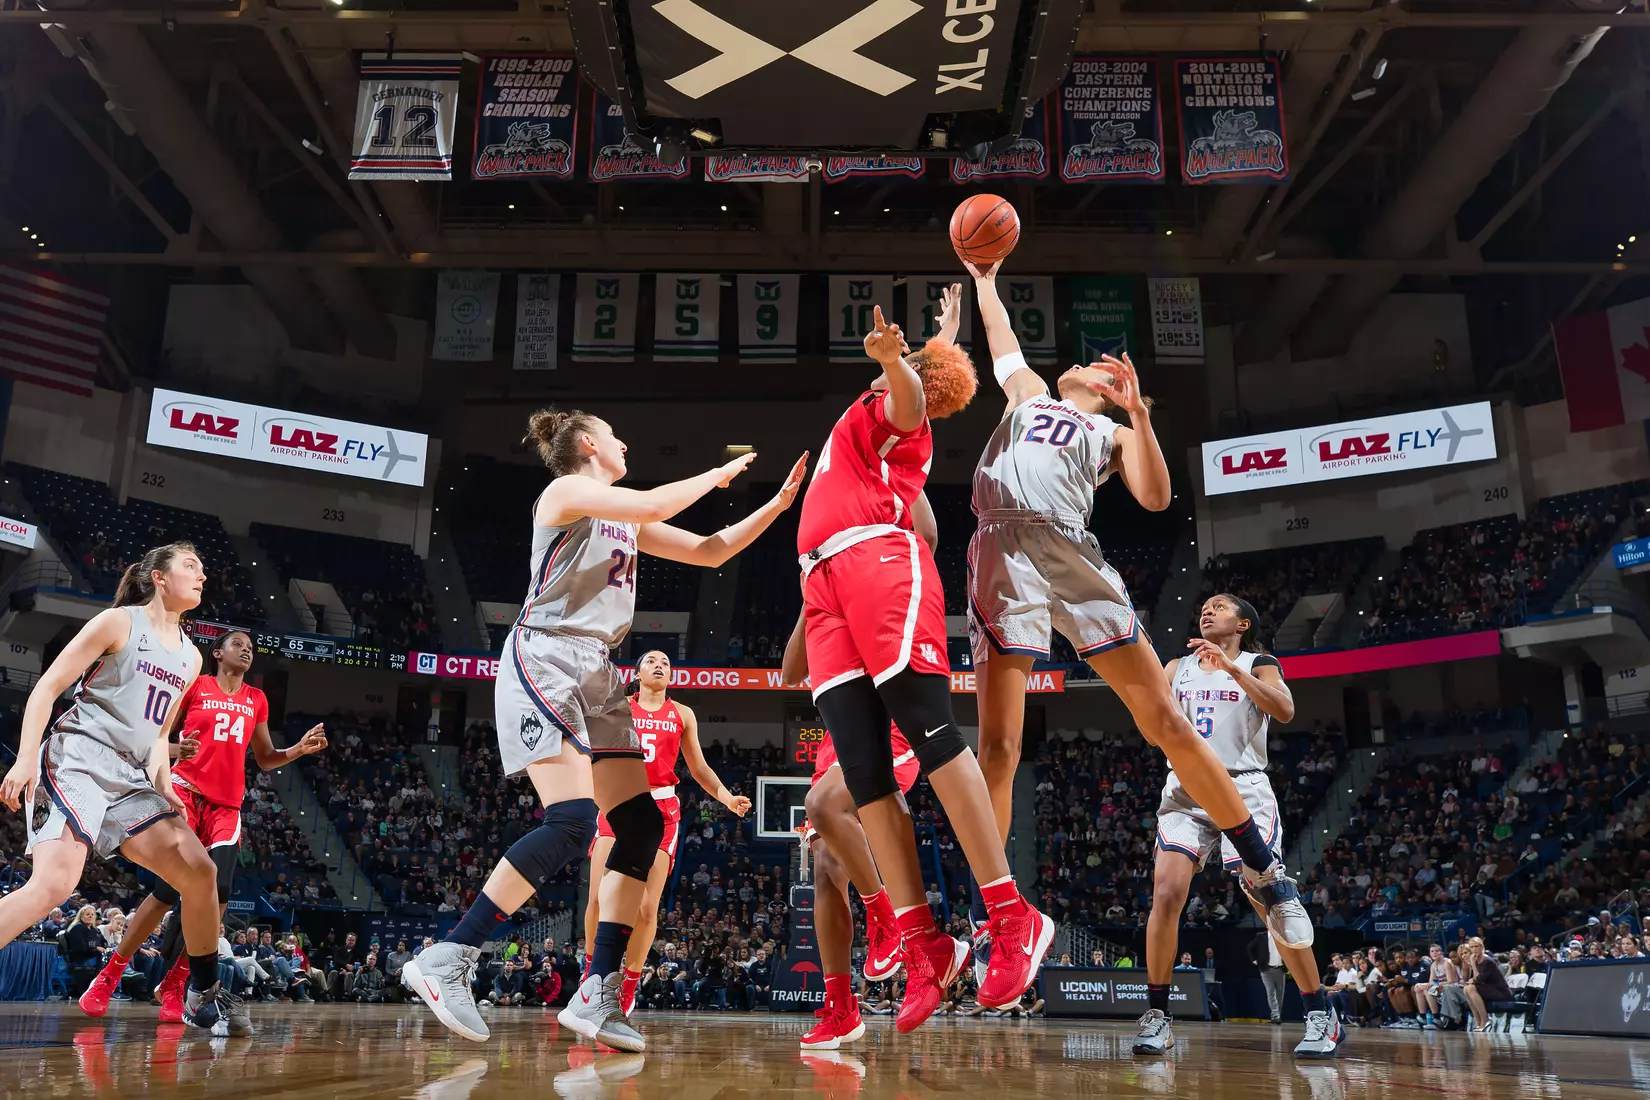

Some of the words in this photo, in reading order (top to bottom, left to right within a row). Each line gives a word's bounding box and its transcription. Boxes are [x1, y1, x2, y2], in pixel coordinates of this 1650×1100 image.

[488, 58, 573, 73] 1999-2000
[934, 48, 988, 95] XL
[1072, 62, 1148, 74] 2003-2004
[1189, 62, 1265, 73] 2014-2015
[493, 73, 563, 88] REGULAR
[1075, 74, 1143, 85] EASTERN
[1182, 73, 1274, 84] NORTHEAST
[497, 88, 559, 103] SEASON
[1064, 87, 1152, 99] CONFERENCE
[1194, 85, 1263, 96] DIVISION
[1063, 100, 1151, 112] CHAMPIONS
[1184, 95, 1275, 107] CHAMPIONS
[482, 103, 571, 118] CHAMPIONS
[1073, 112, 1109, 120] REGULAR
[370, 105, 438, 148] 12
[593, 304, 617, 339] 2
[674, 303, 699, 337] 5
[756, 304, 779, 340] 9
[1020, 308, 1046, 343] 9
[1080, 313, 1126, 323] CHAMPIONS
[170, 407, 239, 440] LAZ
[1027, 402, 1095, 432] HUSKIES
[1024, 414, 1078, 447] 20
[193, 432, 237, 445] PARKING
[270, 424, 339, 455] LAZ
[342, 438, 385, 461] FLY
[1318, 433, 1391, 462] LAZ
[1398, 427, 1442, 451] FLY
[270, 446, 308, 459] AIRPORT
[311, 452, 350, 465] PARKING
[1221, 447, 1287, 475] LAZ
[1321, 458, 1361, 471] AIRPORT
[1365, 452, 1407, 467] PARKING
[141, 472, 166, 488] 232
[1483, 487, 1508, 503] 240
[322, 510, 345, 522] 233
[1285, 517, 1310, 530] 239
[0, 521, 28, 535] ICOH
[1618, 551, 1645, 563] Hilton
[607, 548, 634, 594] 24
[257, 634, 280, 648] 2:53
[289, 640, 304, 650] 65
[9, 643, 29, 656] 107
[390, 653, 406, 663] 2:19
[419, 654, 437, 669] CT
[391, 662, 404, 670] PM
[445, 657, 472, 675] CT
[135, 658, 187, 692] HUSKIES
[1619, 668, 1637, 680] 112
[143, 683, 172, 727] 10
[202, 699, 255, 718] HOUSTON
[213, 712, 245, 745] 24
[632, 718, 678, 734] USTON
[1196, 706, 1215, 739] 5
[800, 728, 824, 741] 2:53
[641, 733, 656, 763] 5
[1060, 982, 1108, 993] UCONN
[771, 990, 828, 1003] TRAVELER
[1066, 993, 1104, 1001] HEALTH
[1116, 993, 1148, 1001] SPORTS
